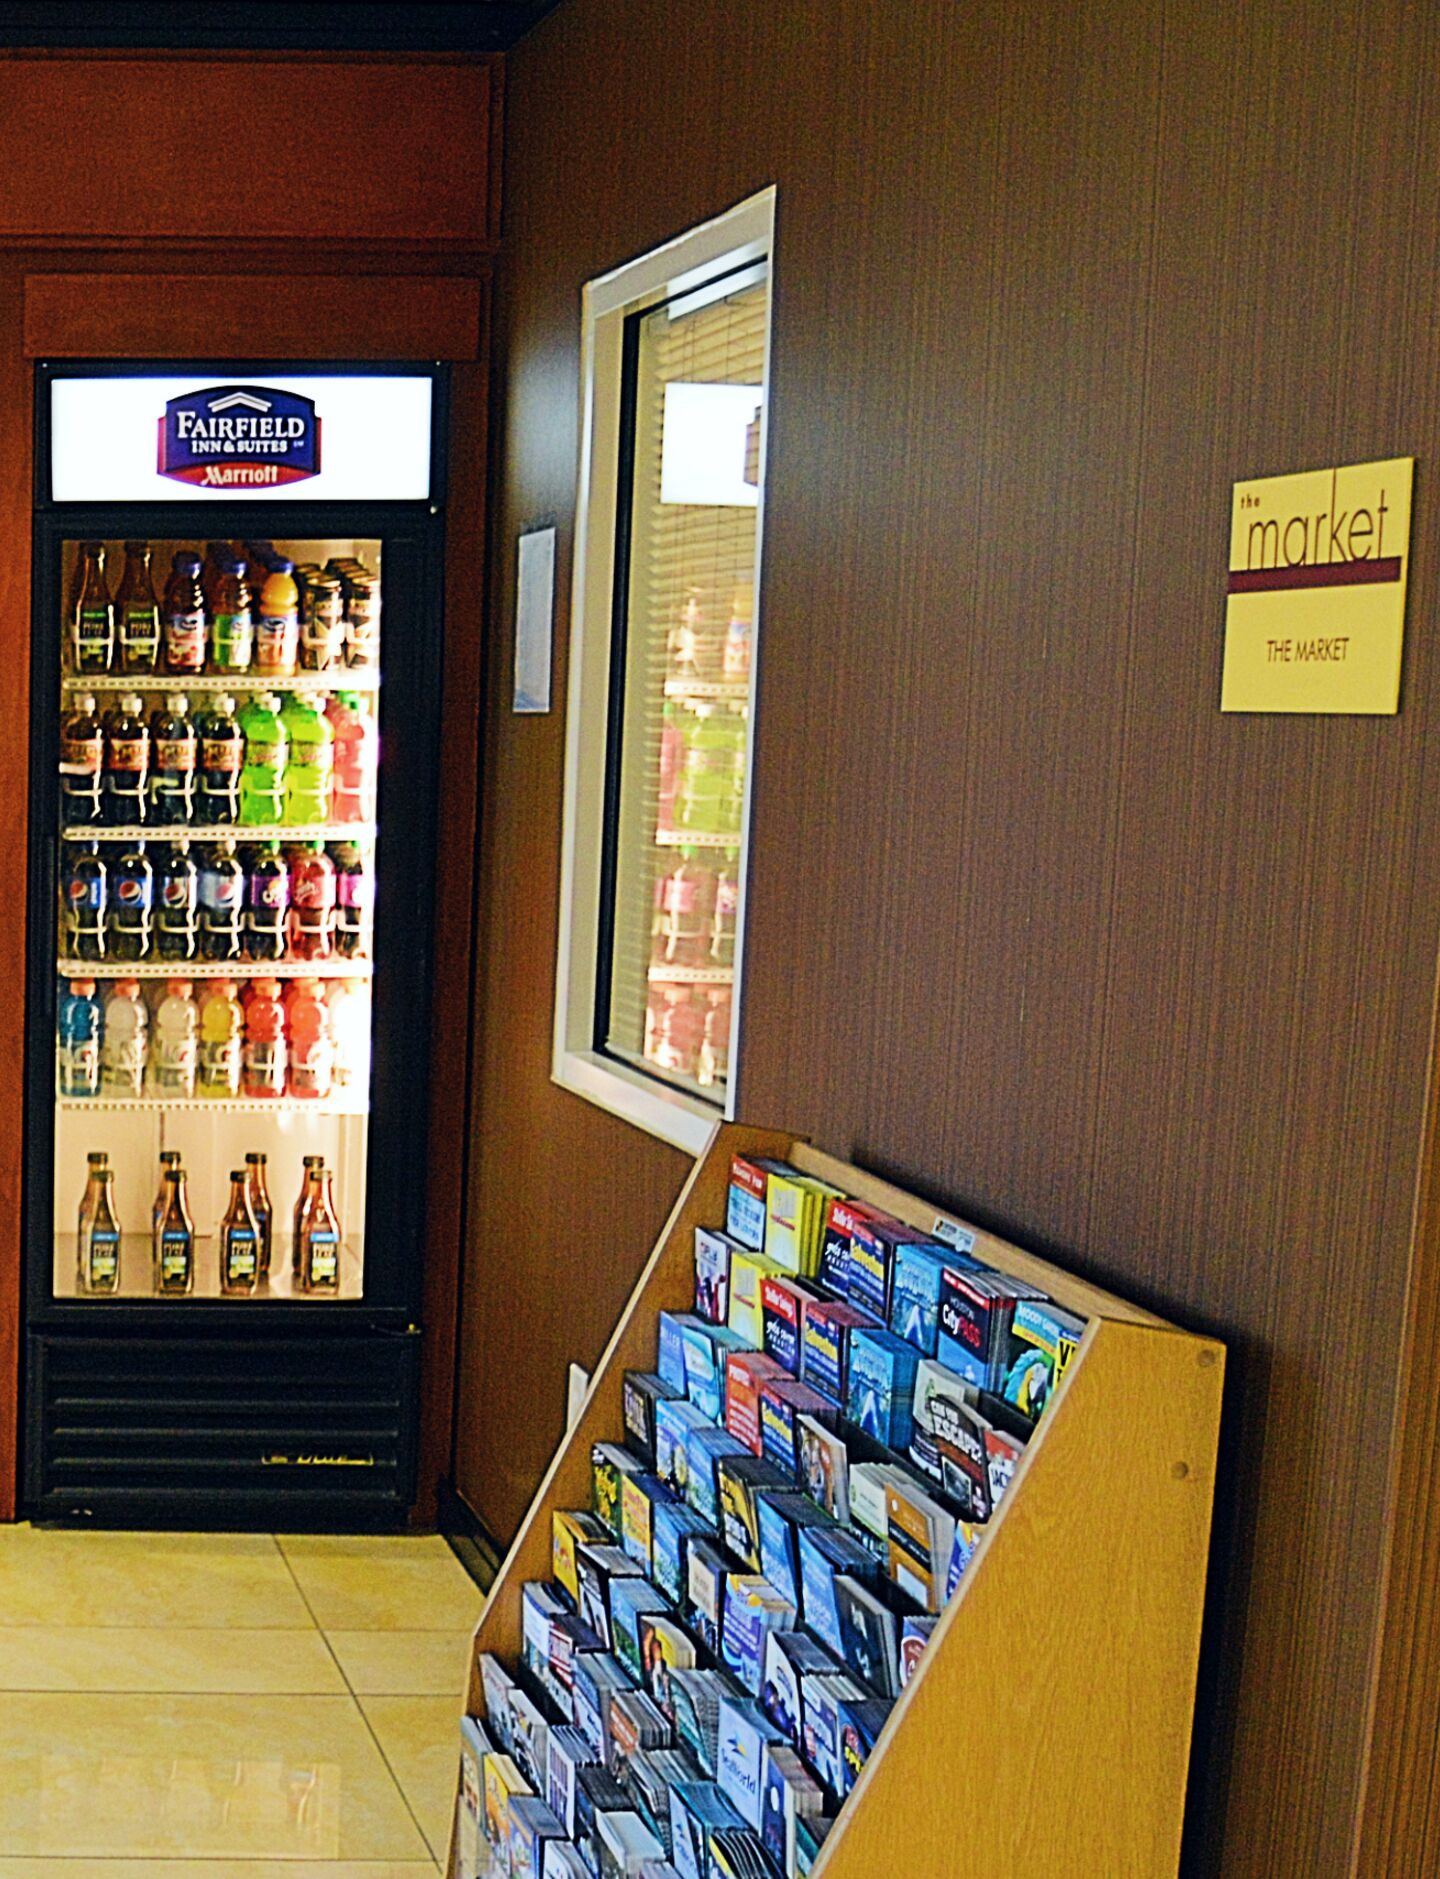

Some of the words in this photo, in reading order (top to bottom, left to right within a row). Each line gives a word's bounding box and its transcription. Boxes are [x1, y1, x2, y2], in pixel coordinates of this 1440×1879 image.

[176, 411, 305, 441] FAIRFIELD
[191, 440, 222, 454] INN
[223, 440, 235, 453] &
[236, 440, 288, 454] SUITES
[200, 465, 278, 487] Marriott
[1240, 493, 1261, 510] the
[1247, 467, 1389, 570] market
[1266, 640, 1291, 663] THE
[1295, 637, 1350, 662] MARKET
